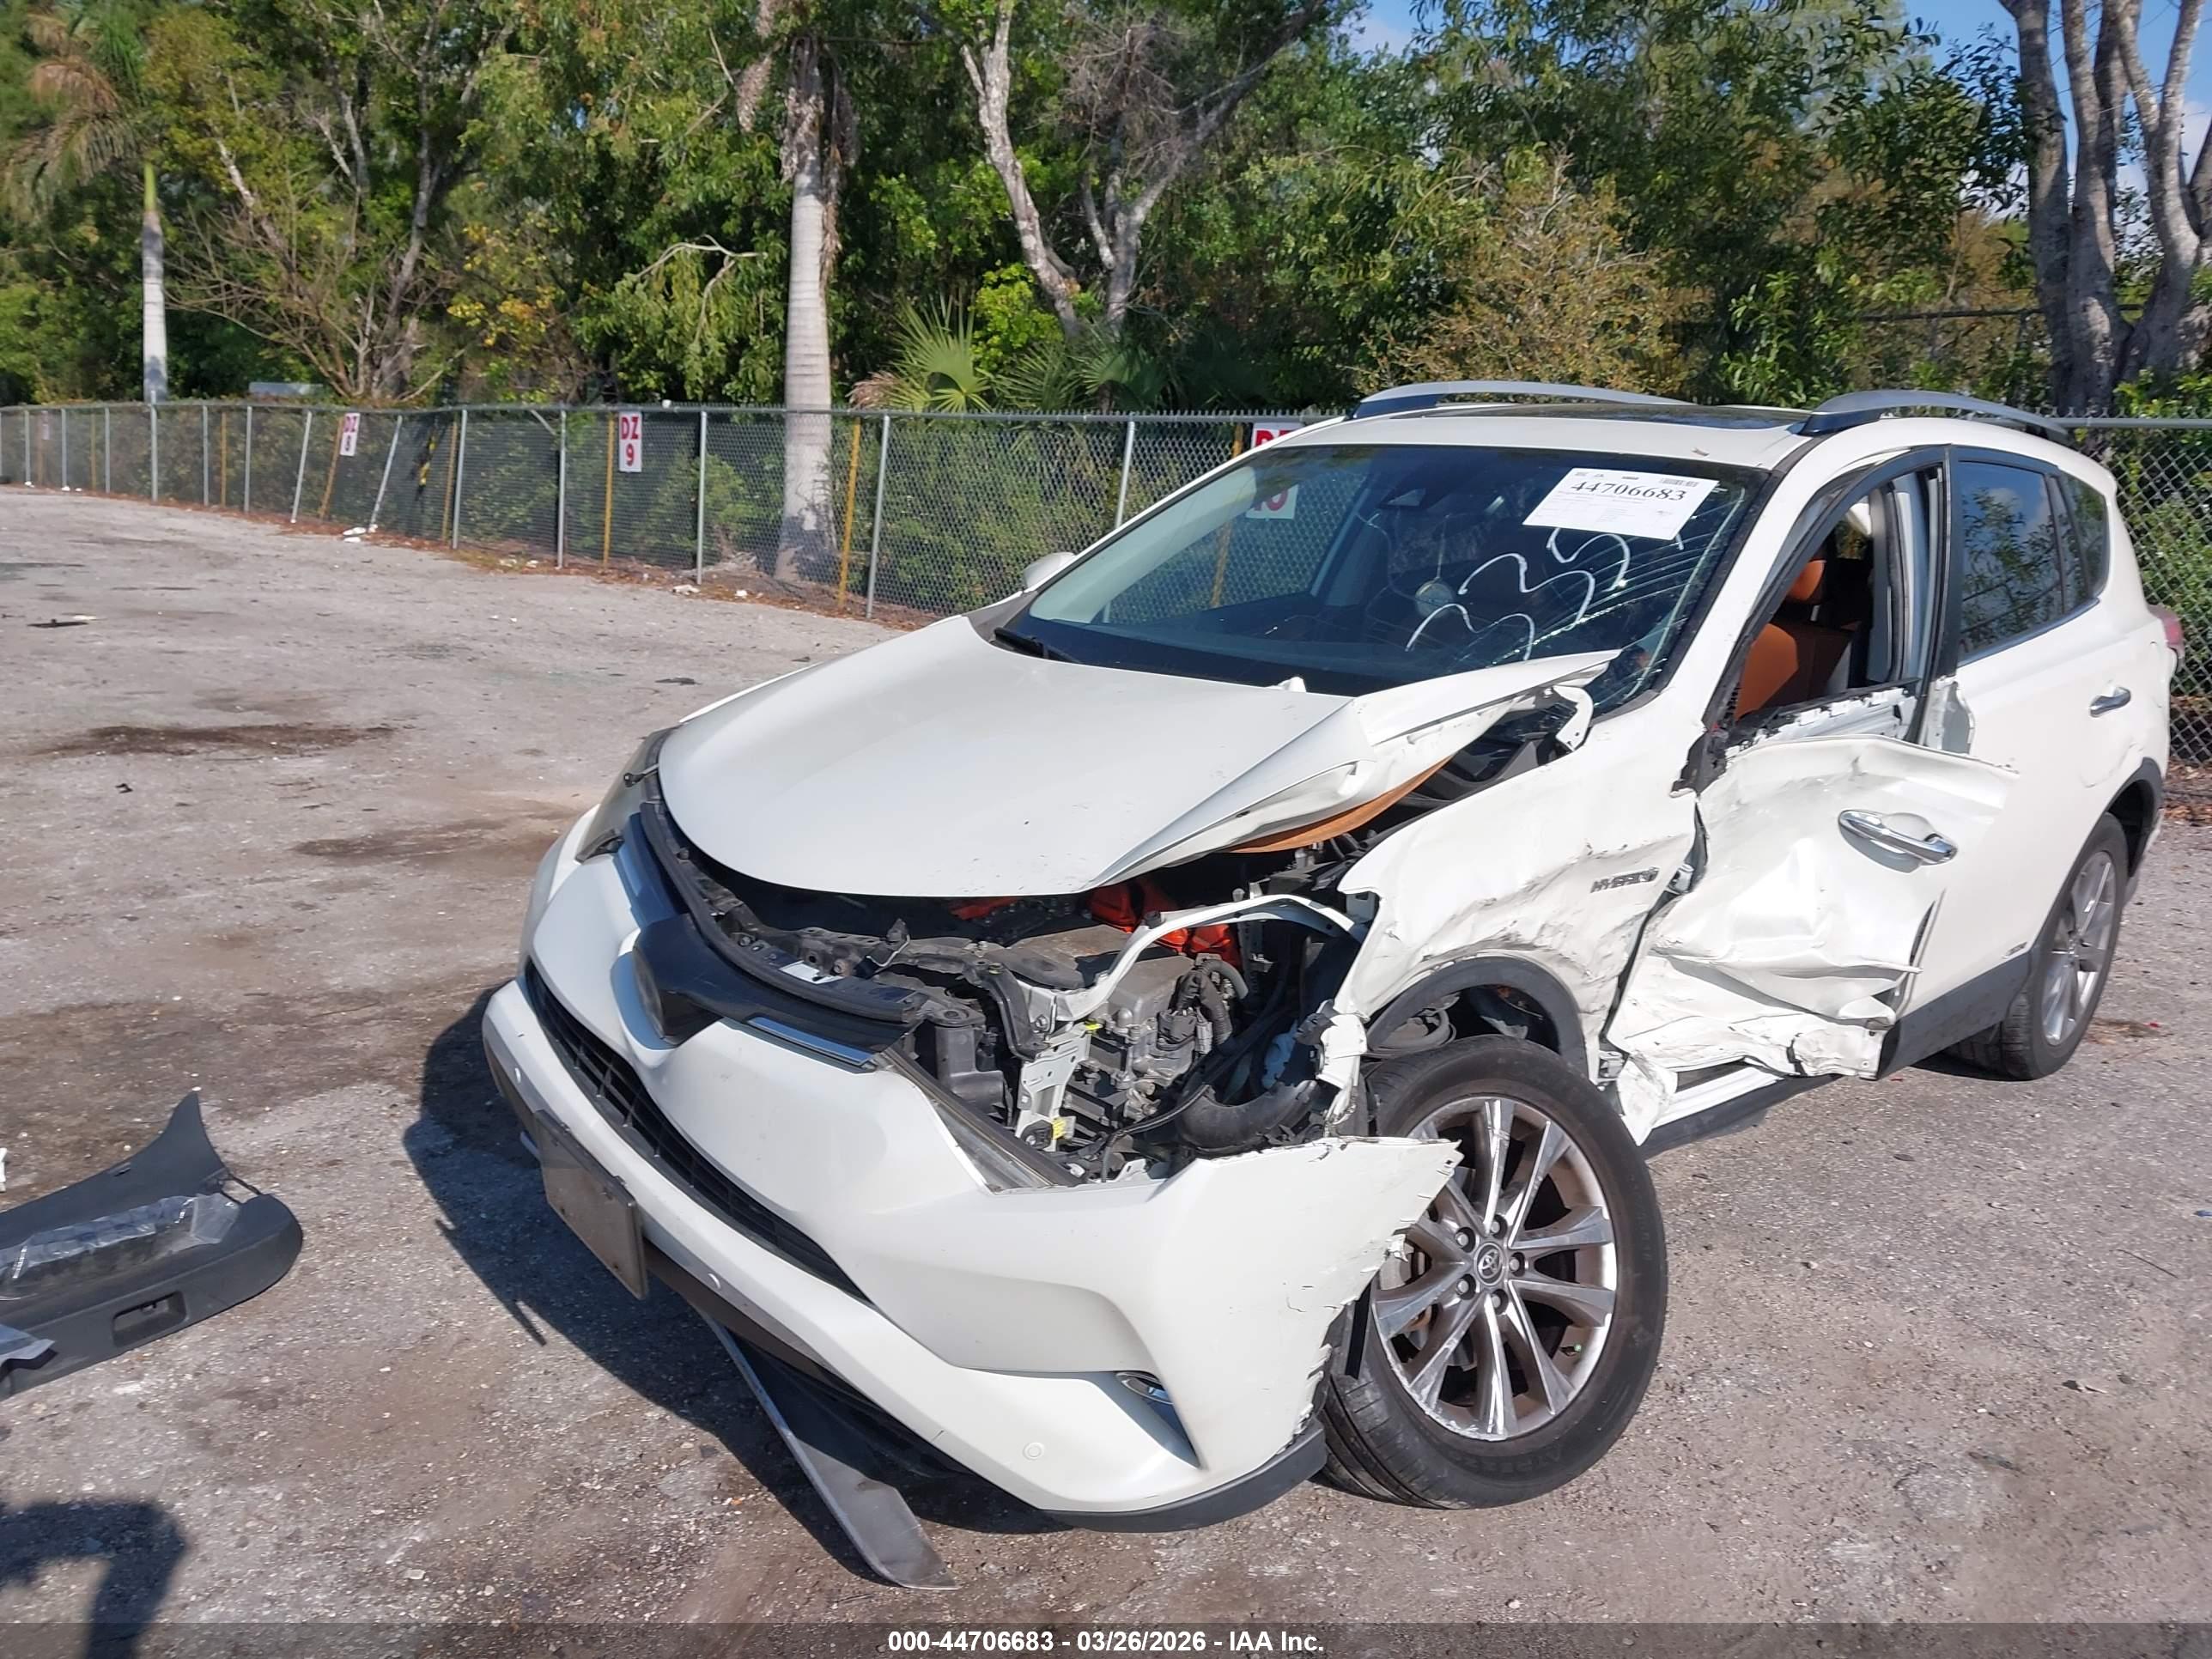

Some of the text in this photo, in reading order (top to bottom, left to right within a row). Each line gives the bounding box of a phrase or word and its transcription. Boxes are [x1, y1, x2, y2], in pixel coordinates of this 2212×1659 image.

[621, 416, 639, 440] DZ
[626, 443, 635, 466] 9
[1571, 480, 1687, 501] 44706683
